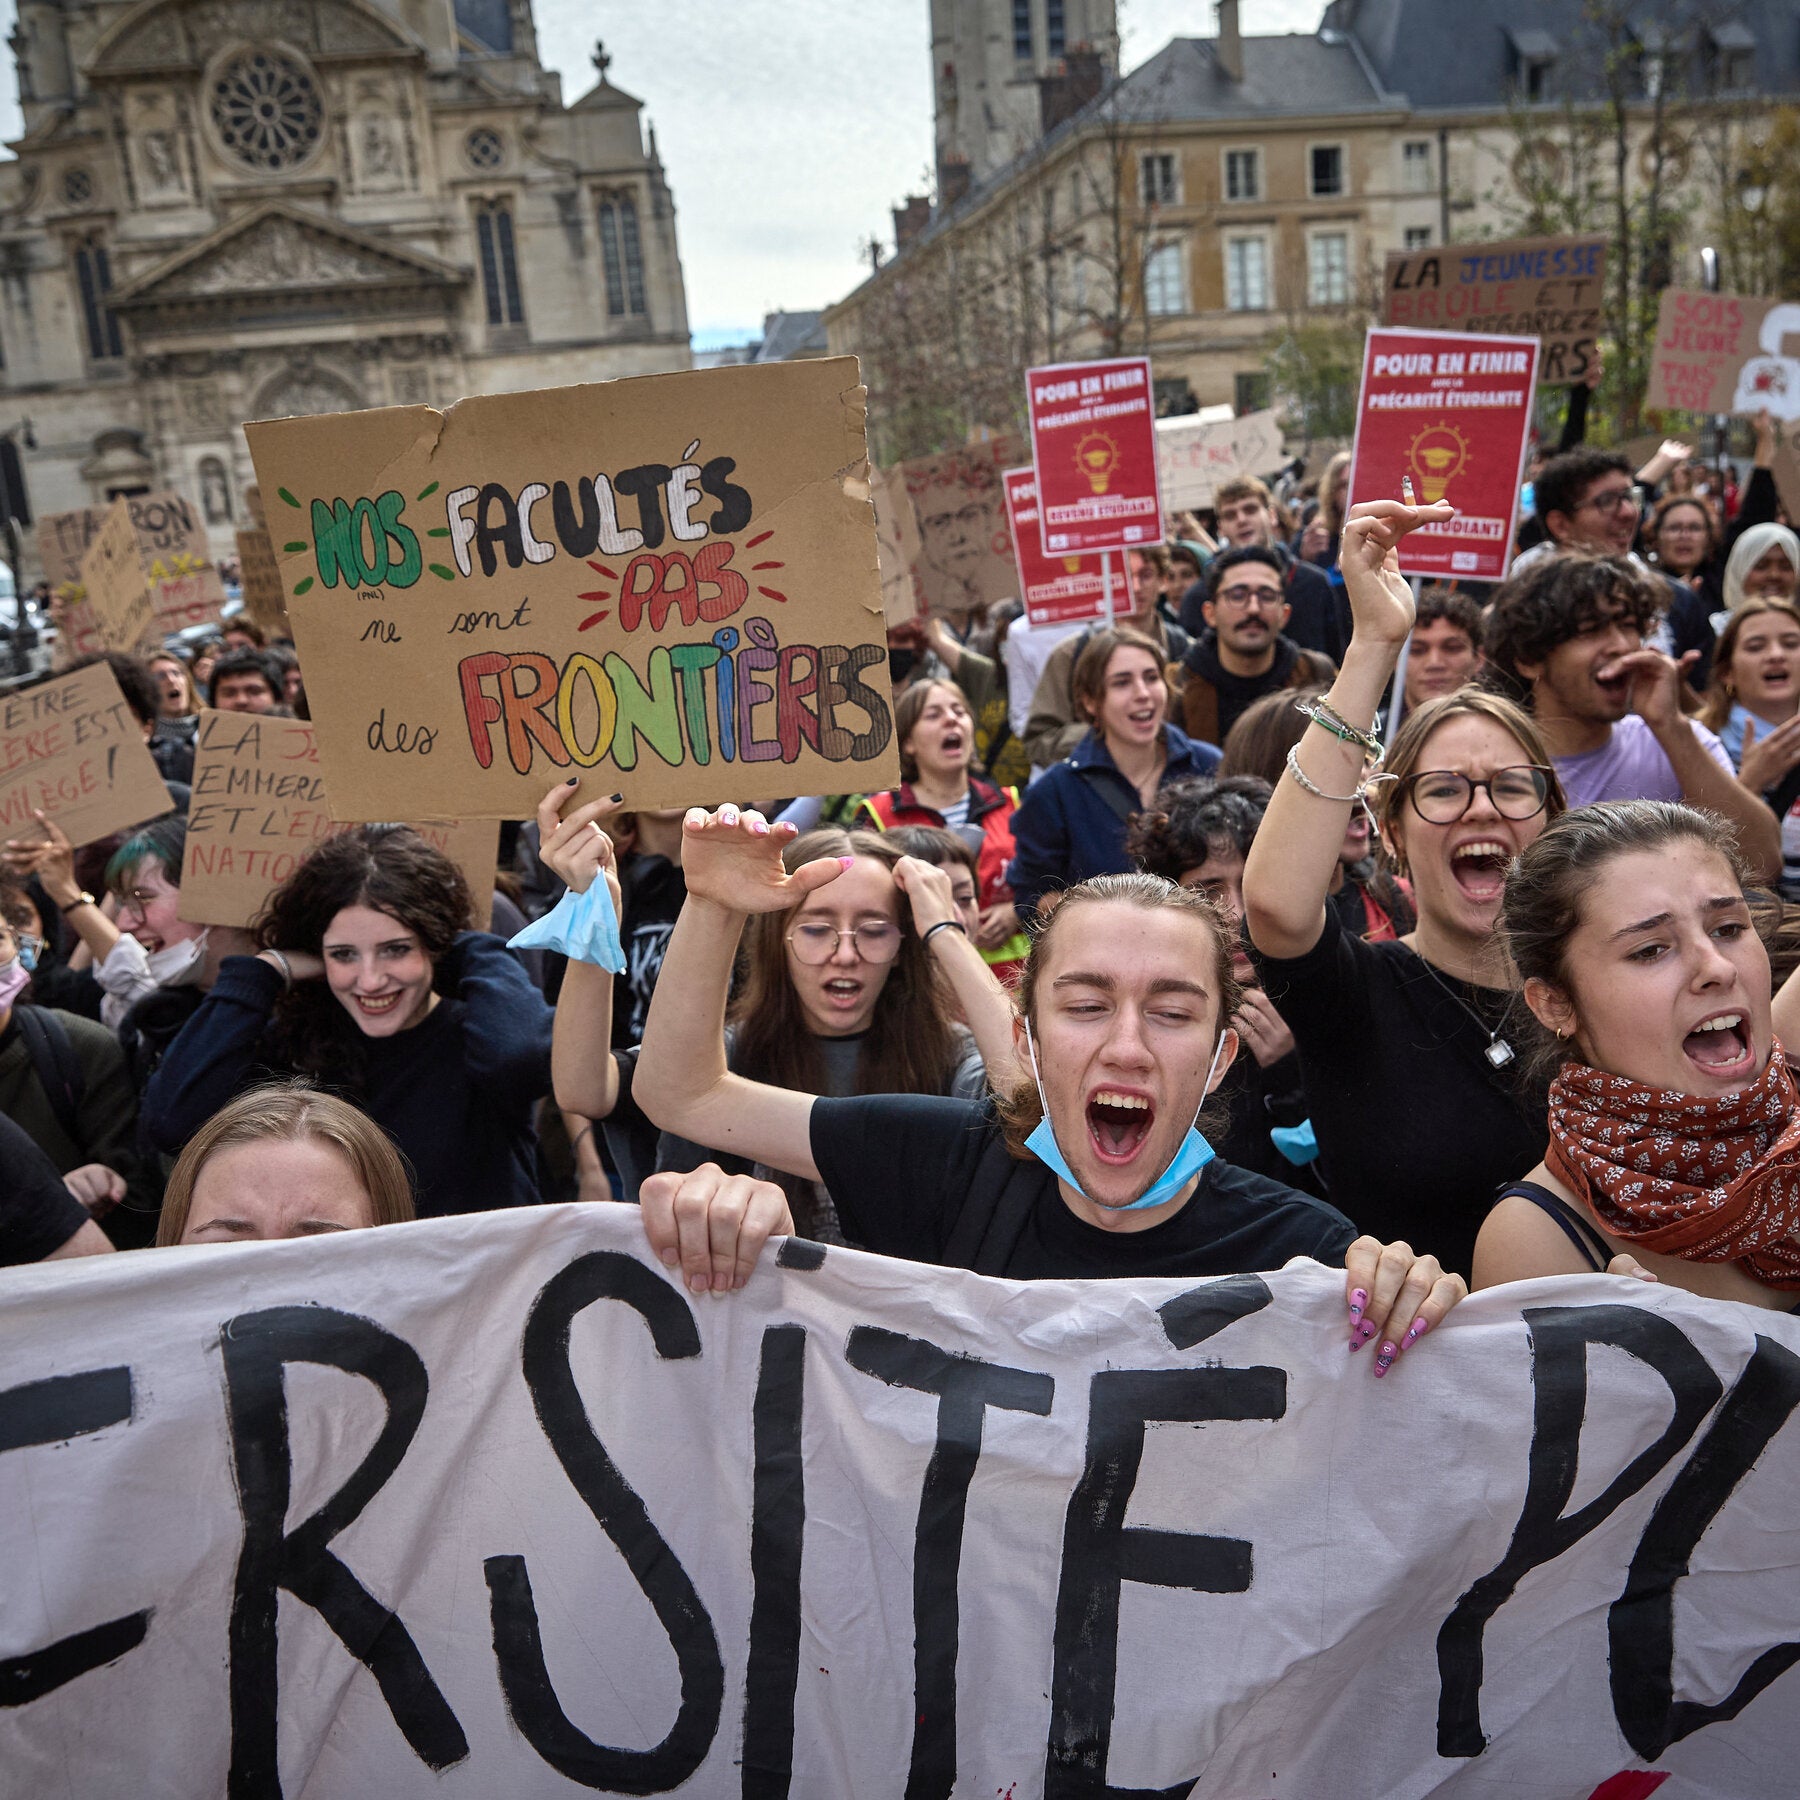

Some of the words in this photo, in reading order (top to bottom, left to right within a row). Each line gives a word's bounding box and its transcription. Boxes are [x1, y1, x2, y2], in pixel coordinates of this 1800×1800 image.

[1393, 257, 1440, 289] LA
[1460, 244, 1603, 284] JEUNESSE
[1535, 279, 1592, 306] ET
[1673, 293, 1745, 330] SOIS
[1372, 353, 1434, 378] POUR
[1435, 351, 1466, 375] EN
[1468, 350, 1529, 374] FINIR
[1540, 339, 1594, 380] RS
[1034, 378, 1080, 405] POUR
[1080, 375, 1101, 396] EN
[1103, 367, 1146, 392] FINIR
[1367, 389, 1444, 410] PRÉCARITÉ
[1445, 388, 1523, 408] ÉTUDIANTE
[311, 490, 422, 590] NOS
[446, 439, 753, 578] FACULTÉS
[356, 588, 385, 602] (PNL)
[359, 619, 402, 642] ne
[447, 597, 532, 634] sont
[618, 541, 749, 632] PAS
[4, 683, 89, 730] ÊTRE
[73, 701, 130, 746] EST
[201, 716, 261, 760] LA
[367, 708, 439, 755] des
[185, 804, 256, 836] ET
